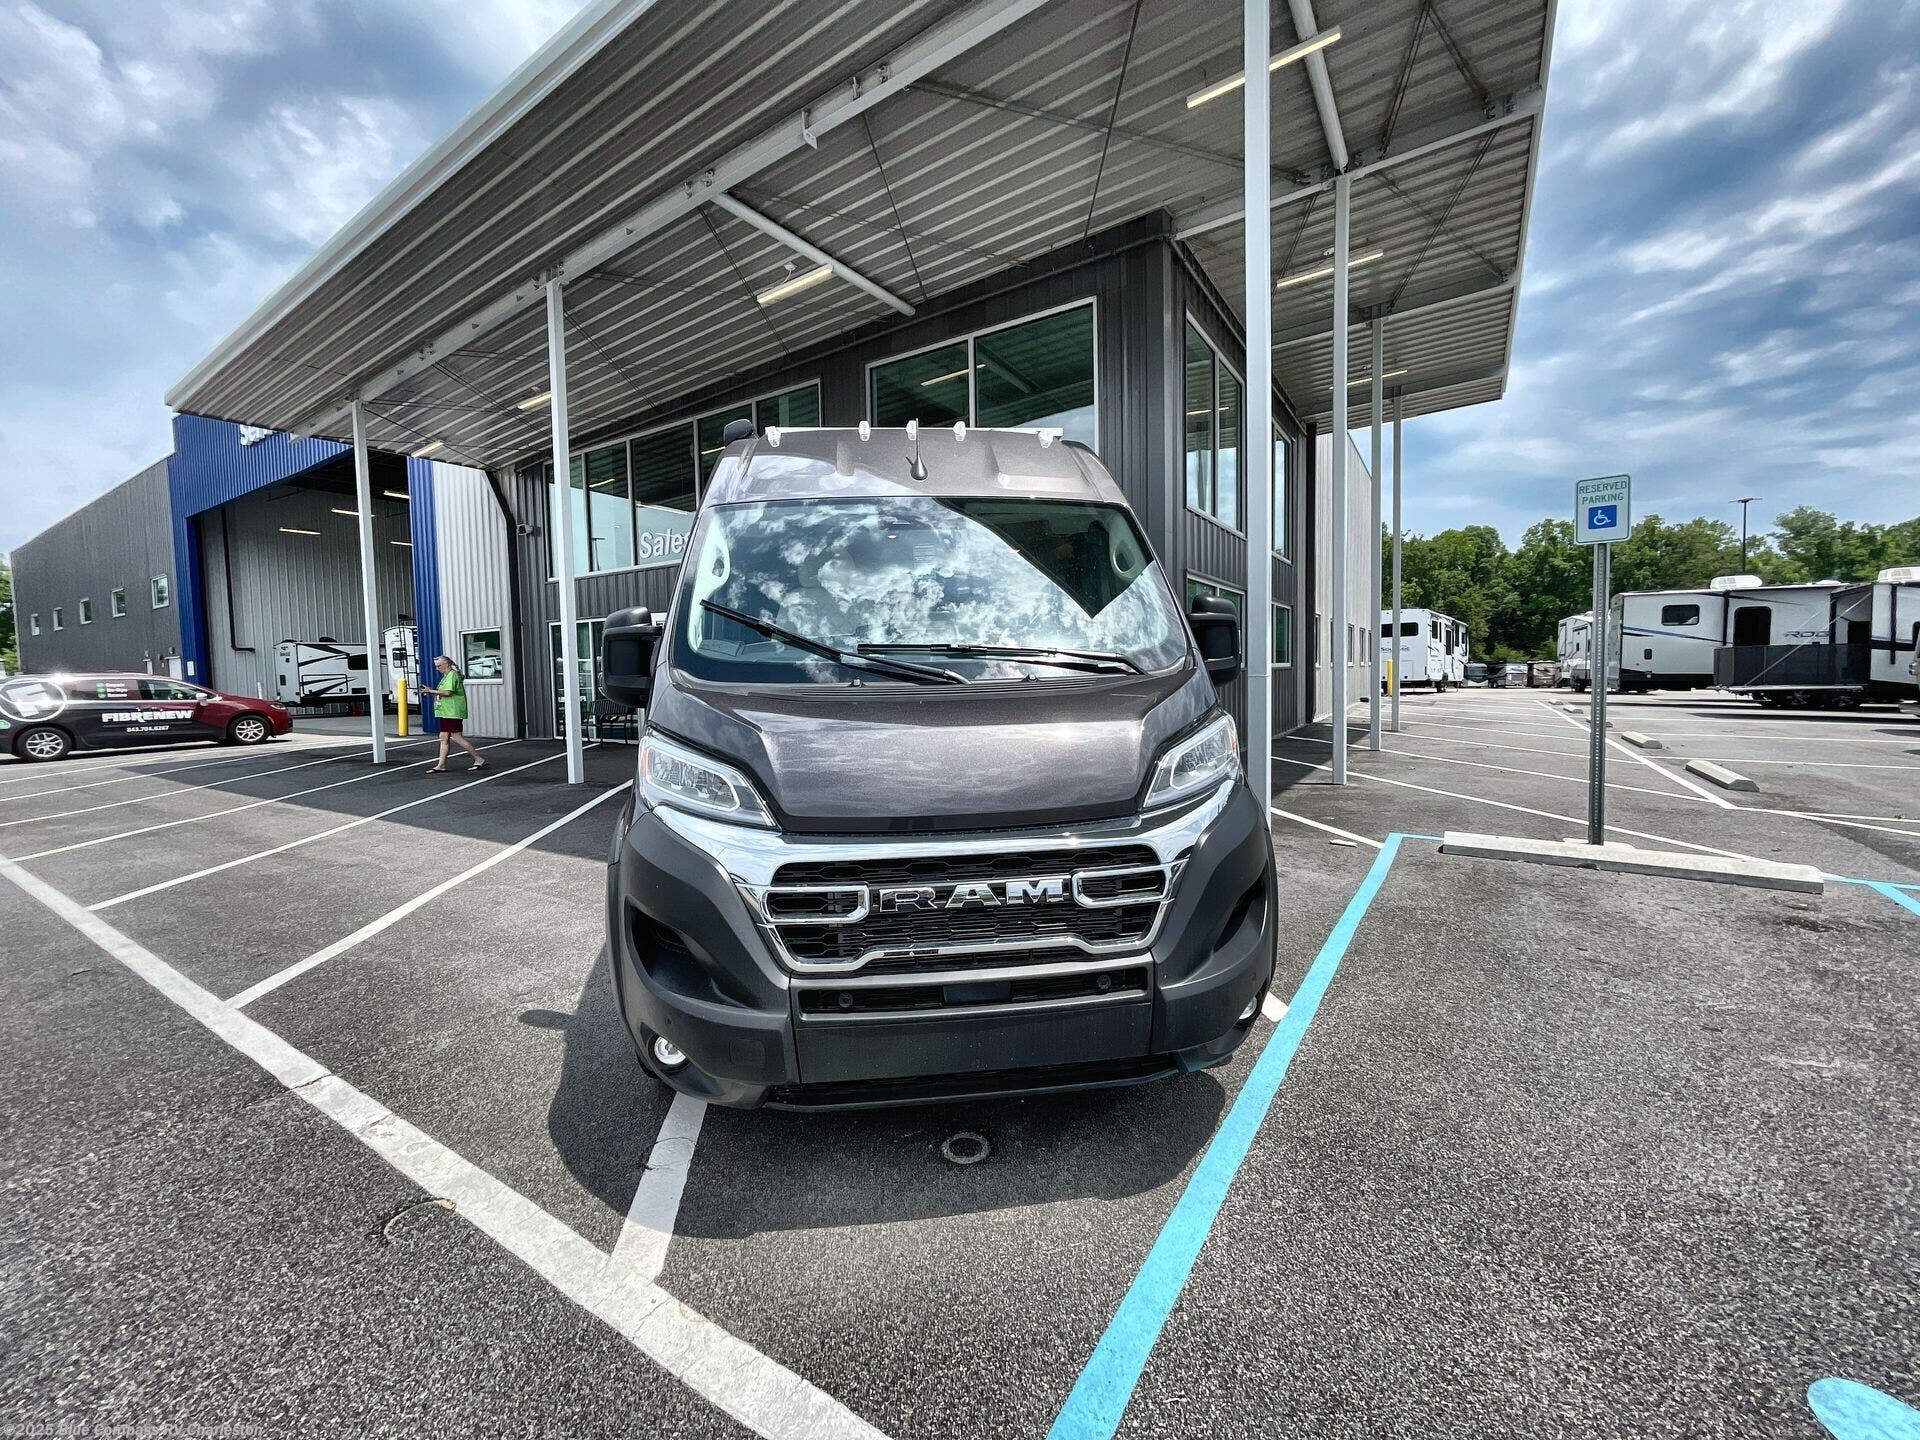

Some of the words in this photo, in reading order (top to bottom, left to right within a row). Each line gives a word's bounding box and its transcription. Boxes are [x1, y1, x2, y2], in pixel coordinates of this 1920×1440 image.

[1579, 481, 1628, 494] RESERVED
[1582, 493, 1624, 505] PARKING
[102, 710, 194, 723] FIBRENEW
[878, 878, 1064, 912] RAM
